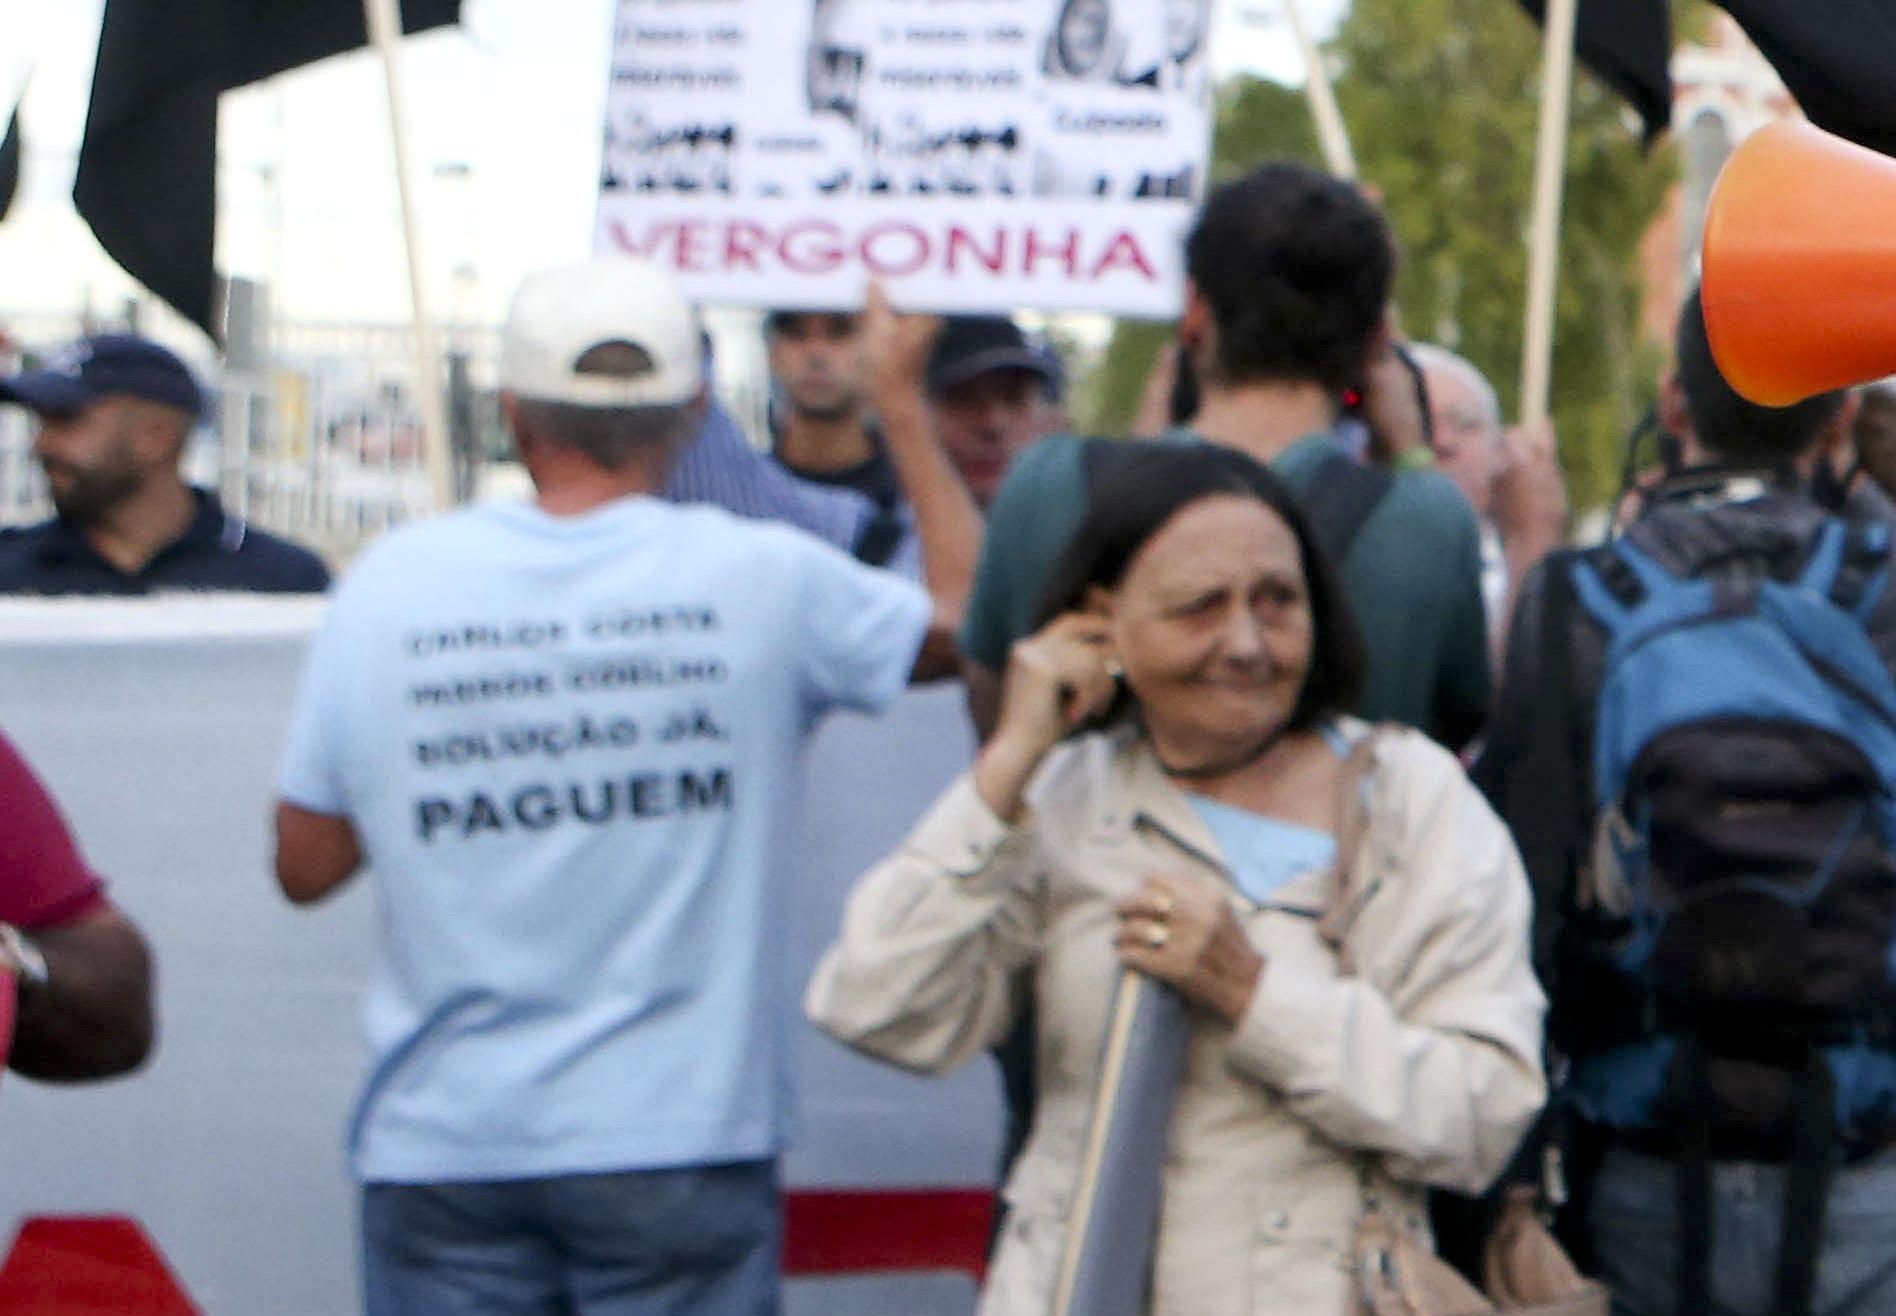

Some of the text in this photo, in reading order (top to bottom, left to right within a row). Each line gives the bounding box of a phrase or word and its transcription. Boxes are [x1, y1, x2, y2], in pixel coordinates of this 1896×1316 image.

[605, 214, 1156, 282] VERGONHA
[415, 715, 640, 765] SOLUÇÃO
[415, 767, 734, 843] PAGUEM
